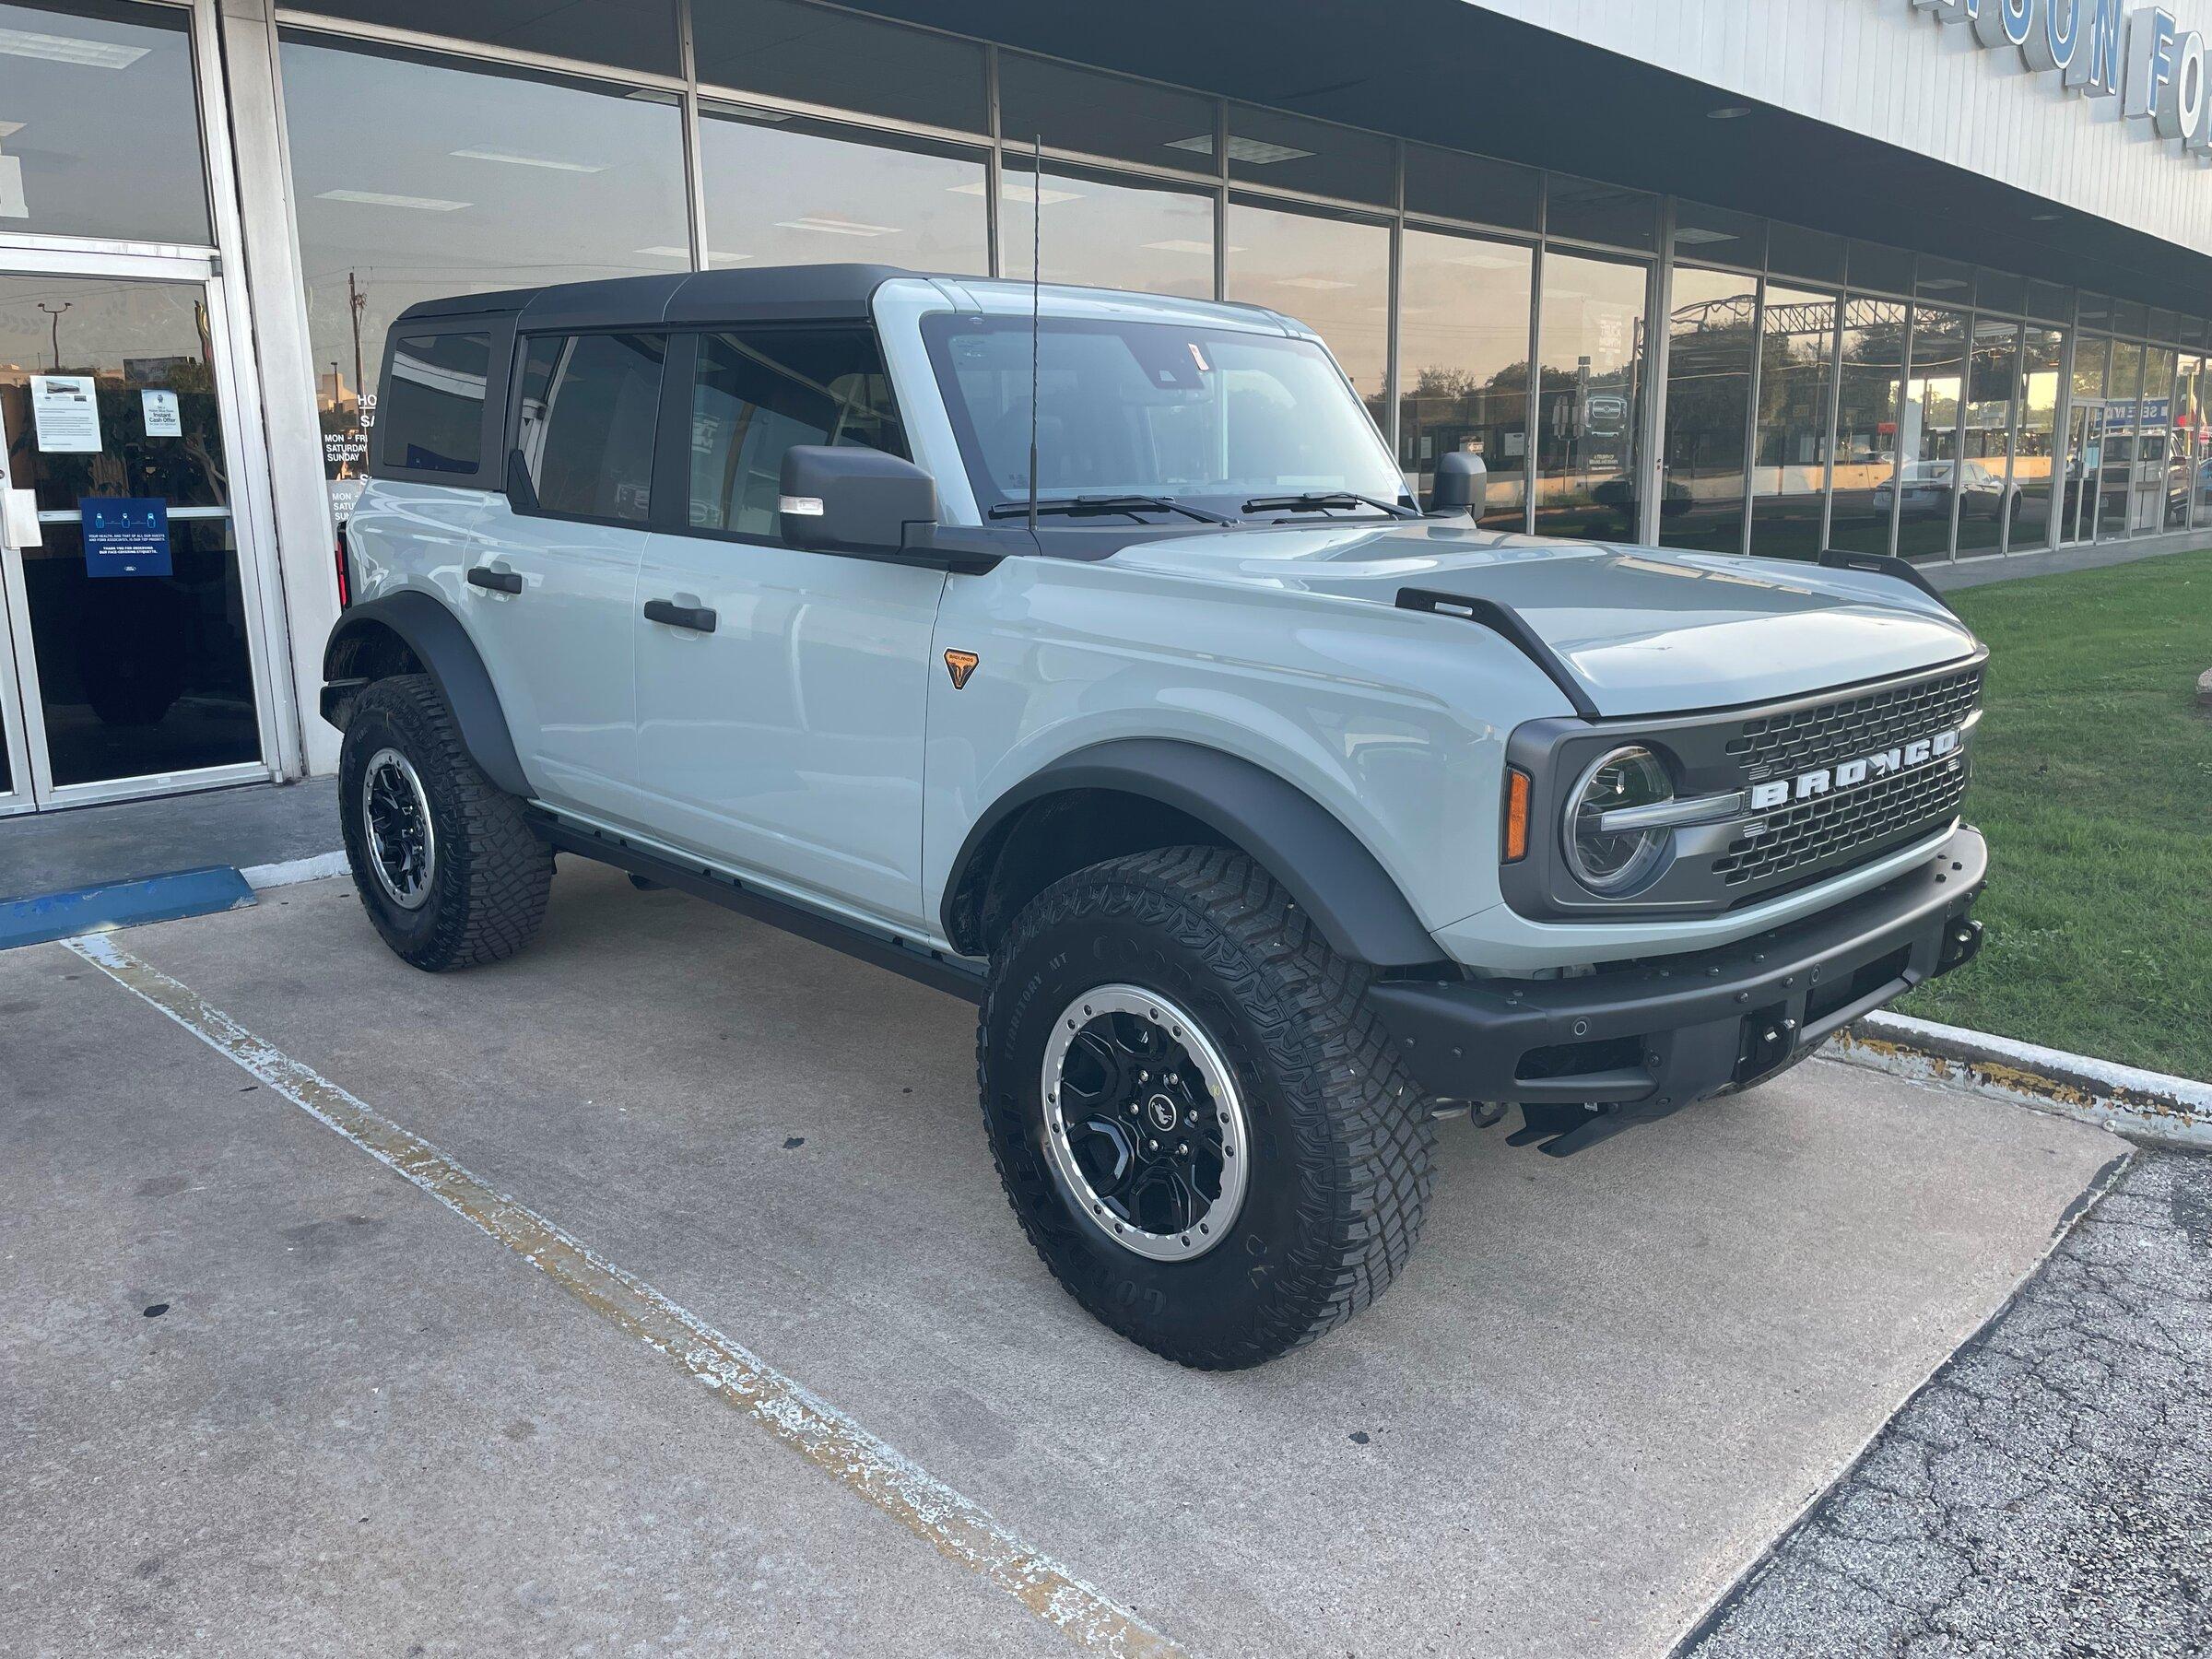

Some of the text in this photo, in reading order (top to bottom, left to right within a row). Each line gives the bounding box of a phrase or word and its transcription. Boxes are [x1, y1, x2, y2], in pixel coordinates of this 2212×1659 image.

[324, 434, 344, 442] MON
[326, 444, 367, 453] SATURDAY
[327, 453, 359, 462] SUNDAY
[332, 493, 352, 501] MON
[1751, 730, 1957, 810] BRONCO
